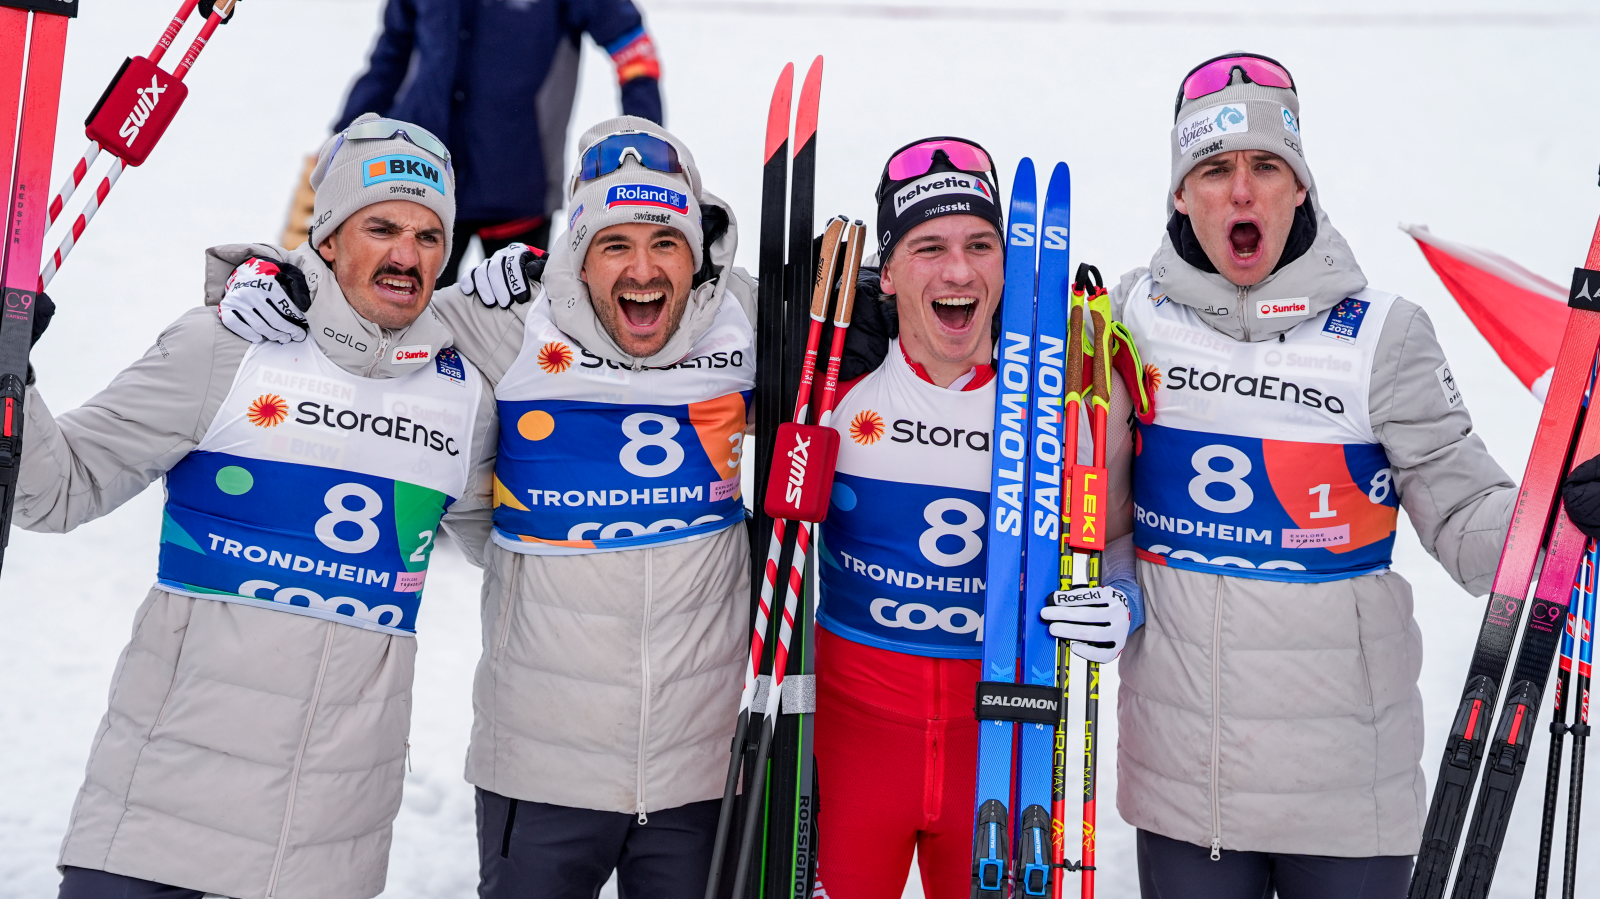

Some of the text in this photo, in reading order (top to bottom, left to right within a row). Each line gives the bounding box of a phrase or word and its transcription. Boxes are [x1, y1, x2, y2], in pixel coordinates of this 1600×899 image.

[1191, 117, 1210, 130] Albert
[390, 159, 439, 183] BKW
[616, 186, 668, 203] Roland
[897, 176, 971, 208] helvetia
[14, 184, 26, 244] REDSTER
[924, 202, 971, 218] swissski
[6, 291, 33, 310] C9
[1271, 302, 1306, 314] Sunrise
[5, 313, 28, 321] CARBON
[1328, 324, 1353, 336] 2025
[323, 326, 368, 352] odlo
[404, 350, 429, 360] Sunrise
[440, 366, 462, 378] 2025
[1166, 366, 1345, 414] StoraEnso
[295, 401, 460, 456] StoraEnso
[890, 418, 993, 452] Stora
[996, 331, 1030, 537] SALOMON
[1034, 334, 1064, 540] SALOMON
[618, 412, 685, 478] 8
[727, 432, 743, 468] 3
[1188, 444, 1254, 514] 8
[1368, 468, 1391, 504] 8
[527, 485, 703, 507] TRONDHEIM
[1082, 473, 1098, 543] LEKI
[1308, 483, 1337, 519] 1
[314, 482, 383, 554] 8
[918, 497, 985, 567] 8
[207, 532, 390, 588] TRONDHEIM
[409, 529, 433, 562] 2
[1490, 597, 1518, 617] C9
[1532, 602, 1560, 622] C9
[1530, 623, 1553, 633] CARBON
[981, 694, 1058, 711] SALOMON
